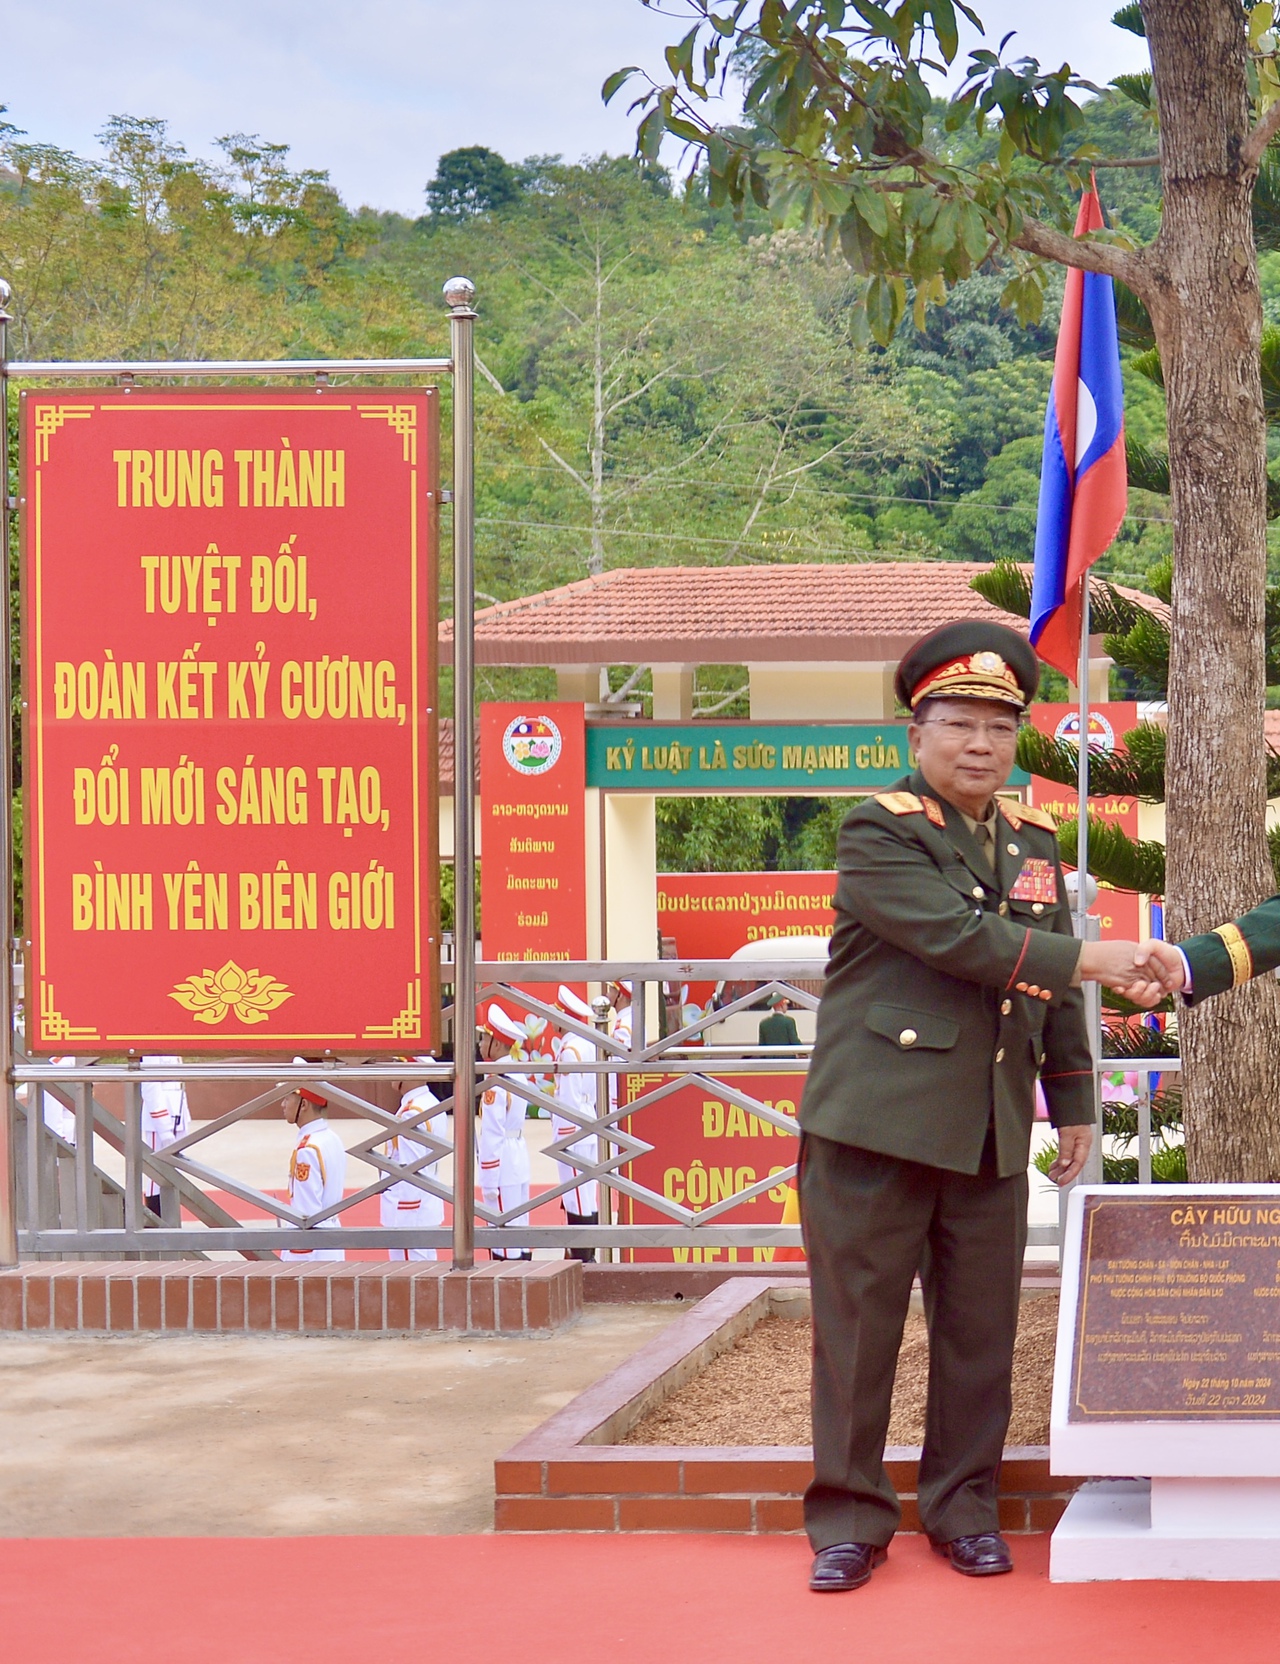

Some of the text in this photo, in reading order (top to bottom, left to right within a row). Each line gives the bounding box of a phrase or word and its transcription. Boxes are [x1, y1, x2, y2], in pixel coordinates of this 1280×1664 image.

[113, 437, 345, 508] TRUNG THÀNH
[141, 534, 317, 627] TUYỆT ĐỐI,
[54, 641, 406, 726] ĐOÀN KẾT KỶ CƯƠNG,
[606, 737, 635, 770] KỶ
[642, 740, 692, 775] LUẬT
[699, 739, 727, 770] LÀ
[732, 739, 776, 769] SỨC
[782, 745, 849, 775] MẠNH
[855, 735, 900, 770] CỦA
[74, 744, 390, 838] ĐỔI MỚI SÁNG TẠO,
[1104, 799, 1129, 815] LÀO
[73, 860, 394, 931] BÌNH YÊN BIÊN GIỚI
[664, 1160, 756, 1213] CỘNG
[1170, 1205, 1208, 1225] CÂY
[1213, 1205, 1251, 1225] HỮU
[1201, 1378, 1210, 1388] 22
[1255, 1378, 1271, 1388] 2024
[1207, 1394, 1221, 1406] 22
[1242, 1394, 1267, 1406] 2024
